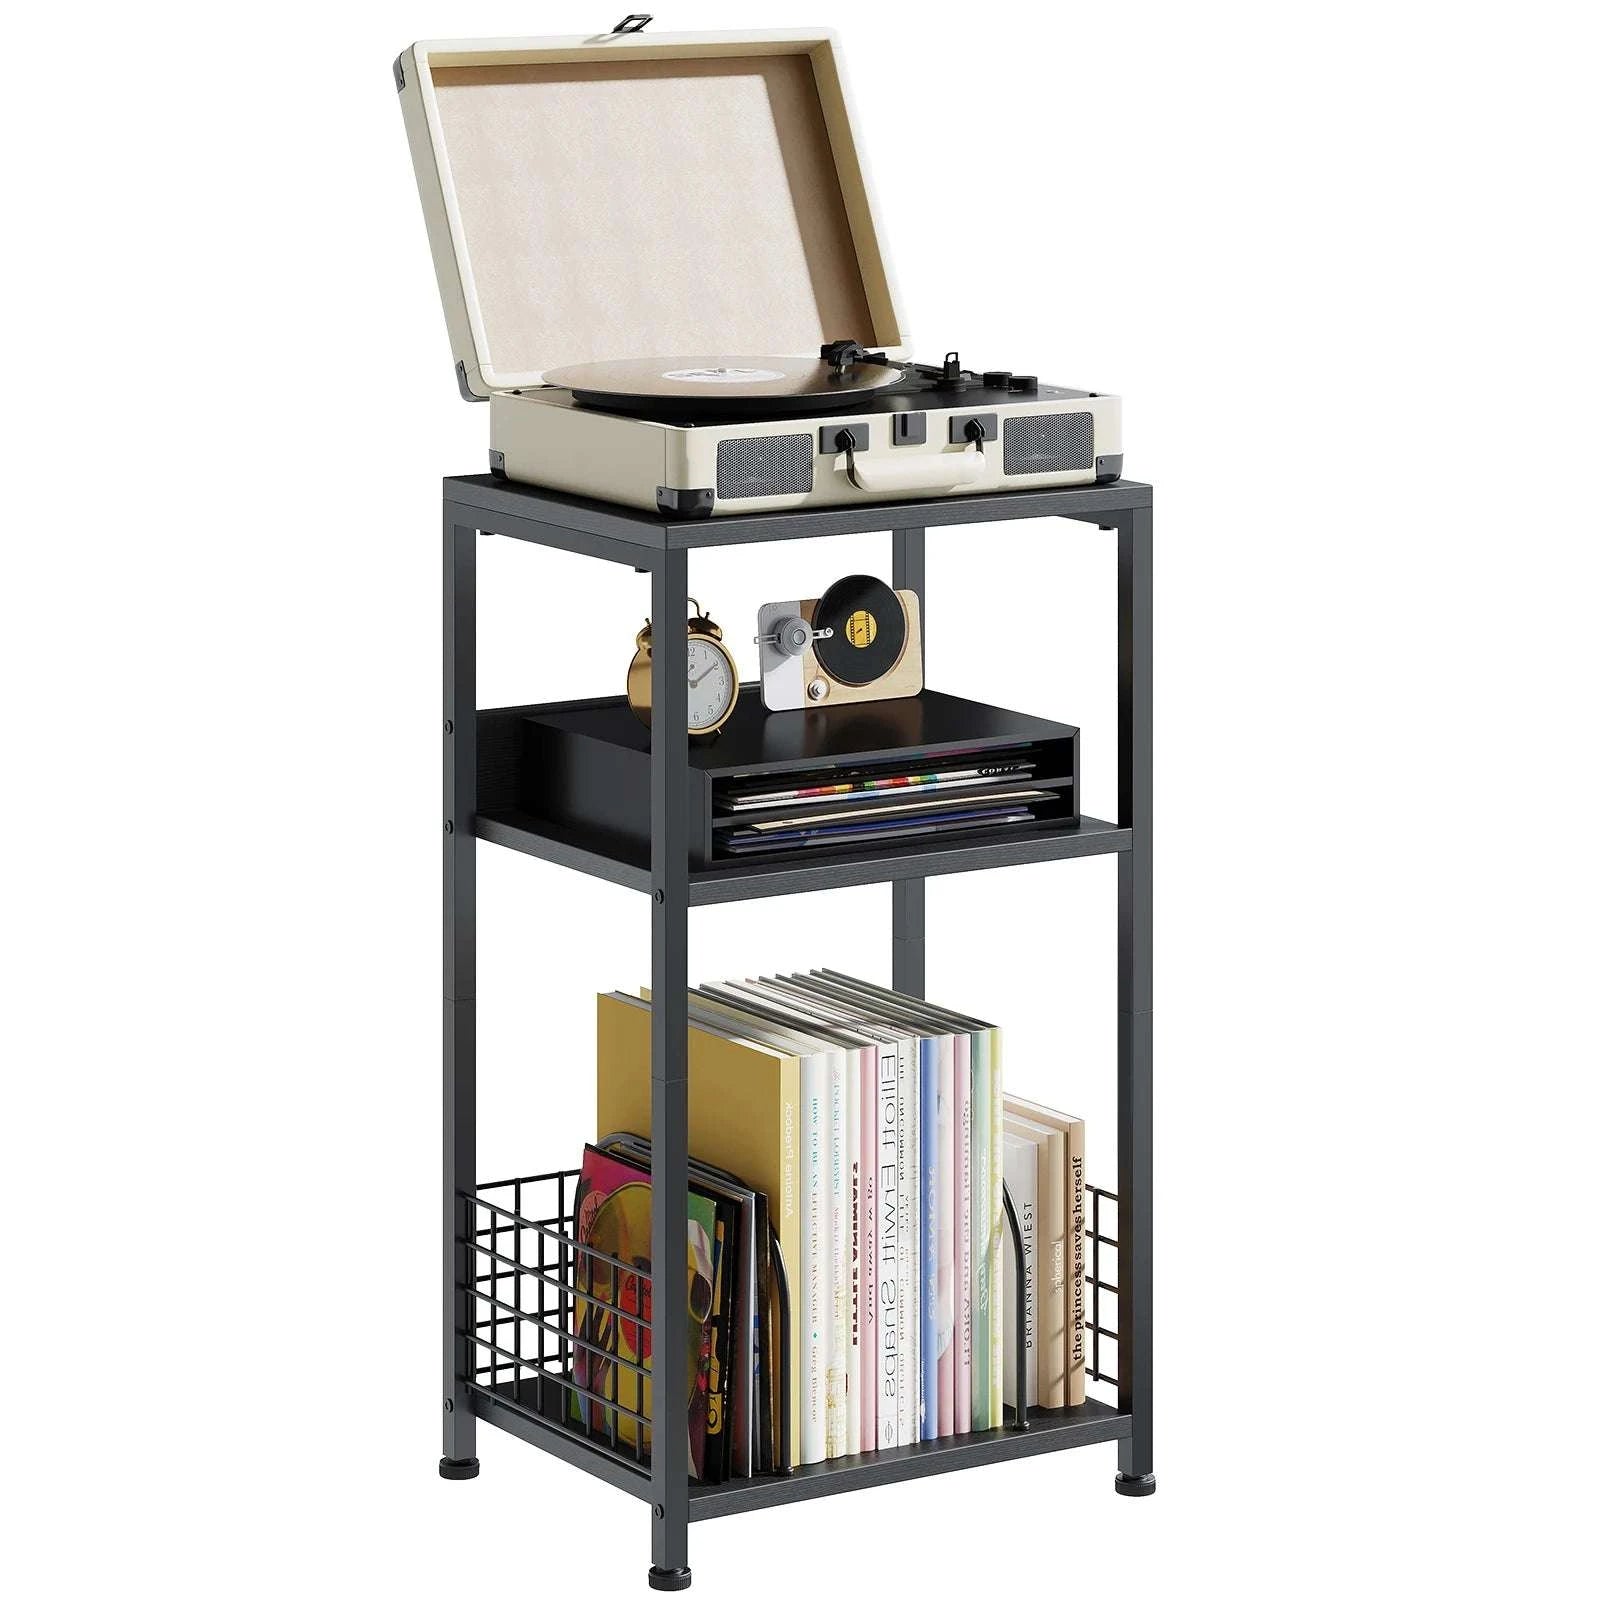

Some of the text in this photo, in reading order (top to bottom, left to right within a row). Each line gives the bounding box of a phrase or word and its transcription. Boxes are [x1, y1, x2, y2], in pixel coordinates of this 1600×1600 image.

[1023, 1201, 1033, 1256] WIEST
[1072, 1155, 1084, 1361] the princess saves herself
